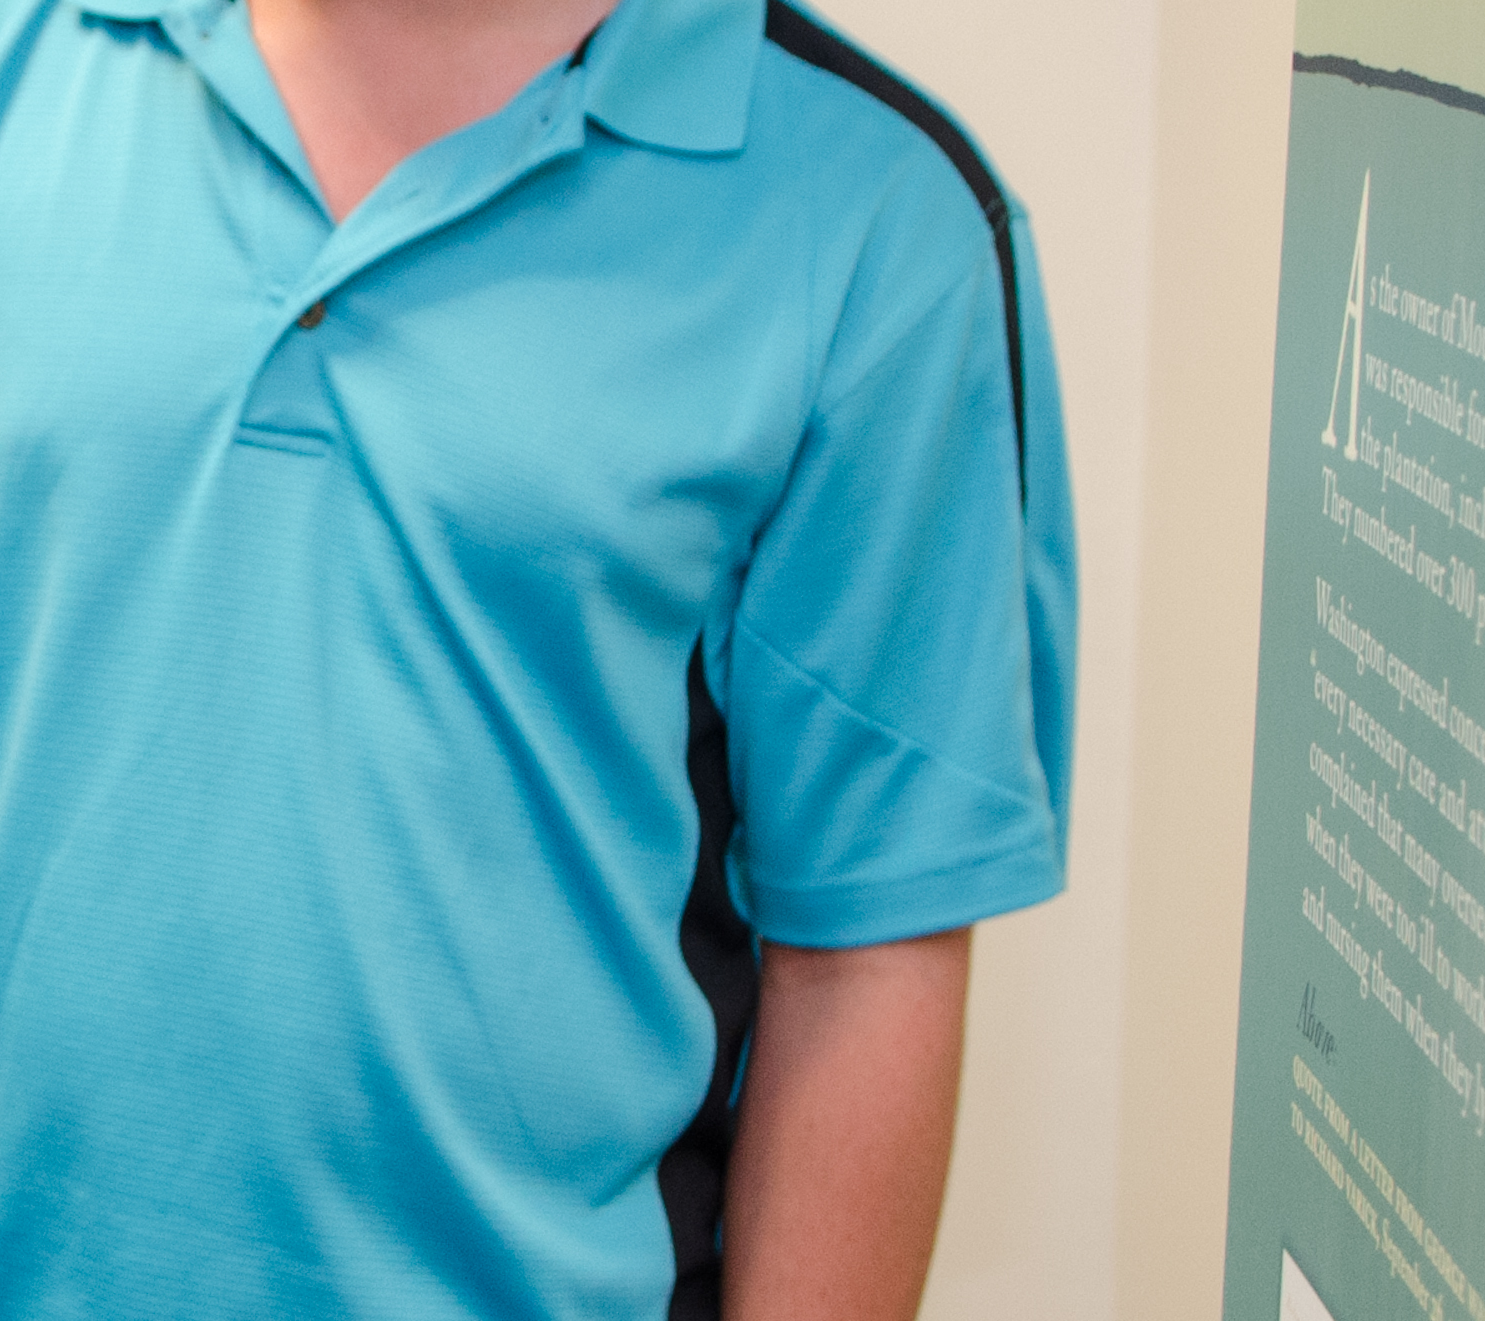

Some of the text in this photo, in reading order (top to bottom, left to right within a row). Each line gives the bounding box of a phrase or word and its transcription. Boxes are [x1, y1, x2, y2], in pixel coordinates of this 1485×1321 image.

[1378, 263, 1399, 317] the
[1400, 289, 1441, 337] owner
[1442, 292, 1459, 345] of
[1365, 352, 1389, 394] was
[1390, 367, 1464, 437] responsible
[1360, 415, 1381, 470] the
[1381, 430, 1455, 530] plantation,
[1322, 465, 1353, 546] They
[1353, 505, 1416, 577] numbered
[1416, 550, 1446, 599] over
[1446, 554, 1475, 619] 300
[1315, 575, 1386, 677] Washington
[1386, 652, 1449, 730] expressed
[1309, 741, 1376, 829] complained
[1377, 791, 1404, 857] that
[1404, 833, 1441, 908] many
[1347, 699, 1407, 792] necessary
[1408, 755, 1437, 806] care
[1437, 779, 1466, 833] and
[1305, 804, 1337, 869] when
[1338, 832, 1365, 910] they
[1365, 873, 1394, 930] were
[1395, 900, 1418, 954] too
[1418, 914, 1436, 975] ill
[1436, 945, 1451, 991] to
[1302, 885, 1325, 933] and
[1326, 912, 1370, 1000] nursing
[1371, 949, 1403, 1024] them
[1405, 993, 1440, 1068] when
[1441, 1030, 1474, 1118] they
[1291, 1101, 1304, 1137] TO
[1324, 1092, 1351, 1146] FROM
[1358, 1137, 1395, 1206] LETTER
